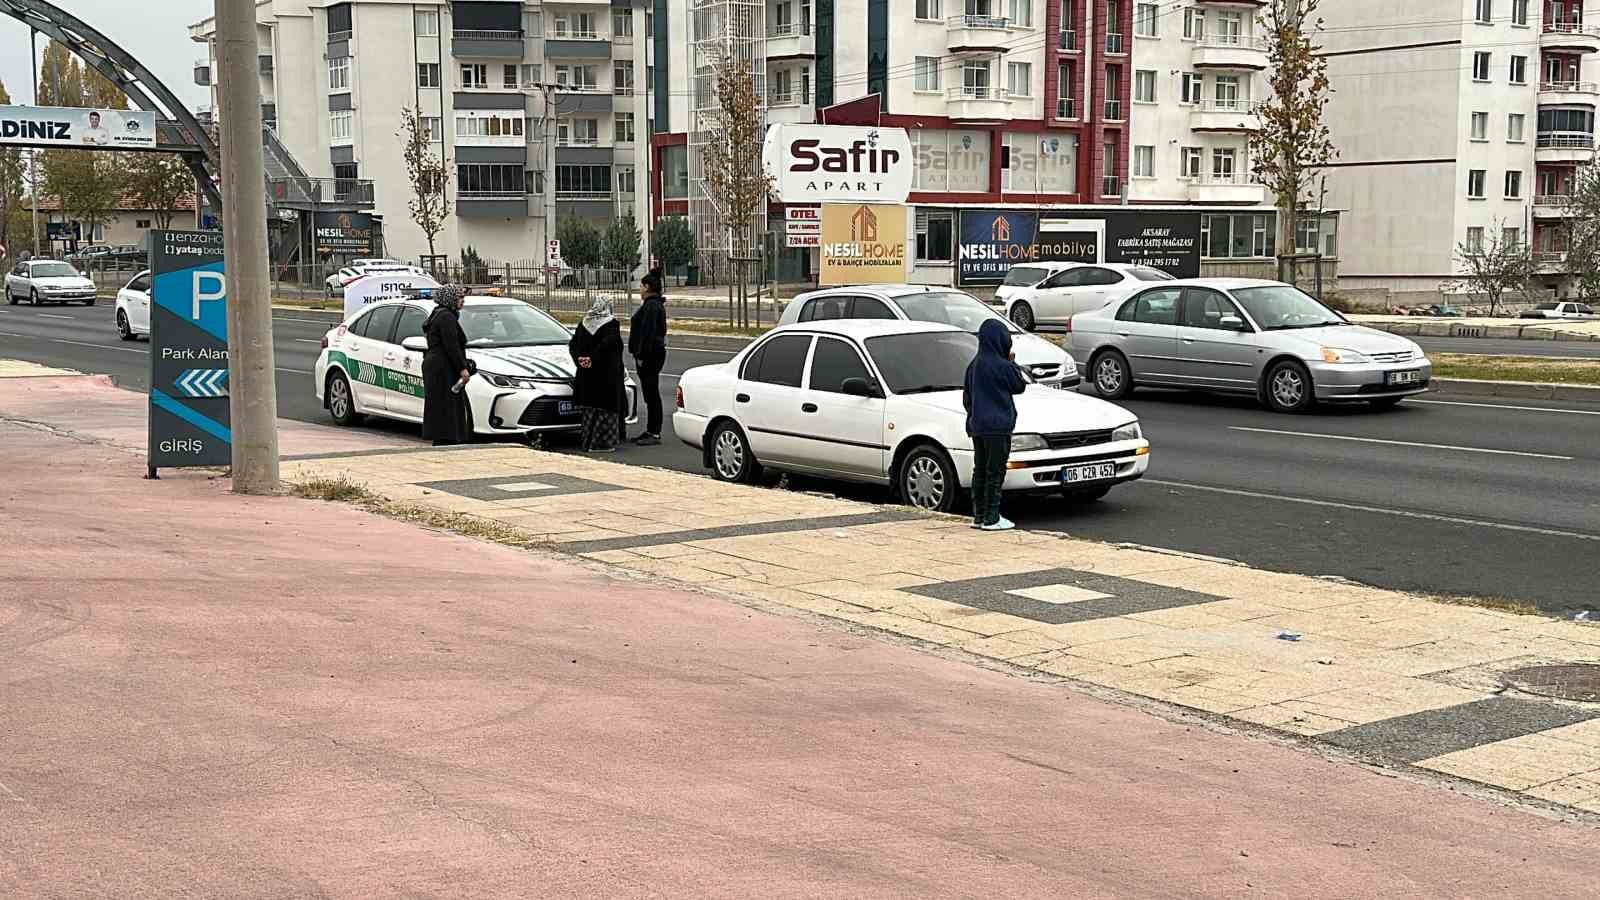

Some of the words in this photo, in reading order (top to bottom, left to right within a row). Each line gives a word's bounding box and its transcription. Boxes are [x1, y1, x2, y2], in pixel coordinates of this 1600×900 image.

[790, 139, 900, 174] Safir
[806, 181, 884, 192] APART
[790, 209, 818, 219] OTEL
[1141, 227, 1171, 237] AKSARAY
[1041, 241, 1096, 257] mobilya
[963, 263, 971, 272] EV
[192, 271, 227, 320] P
[161, 347, 196, 359] Park
[159, 438, 203, 453] GİRİŞ
[1067, 469, 1078, 481] 06
[1082, 466, 1097, 479] CZR
[1099, 464, 1114, 477] 452
